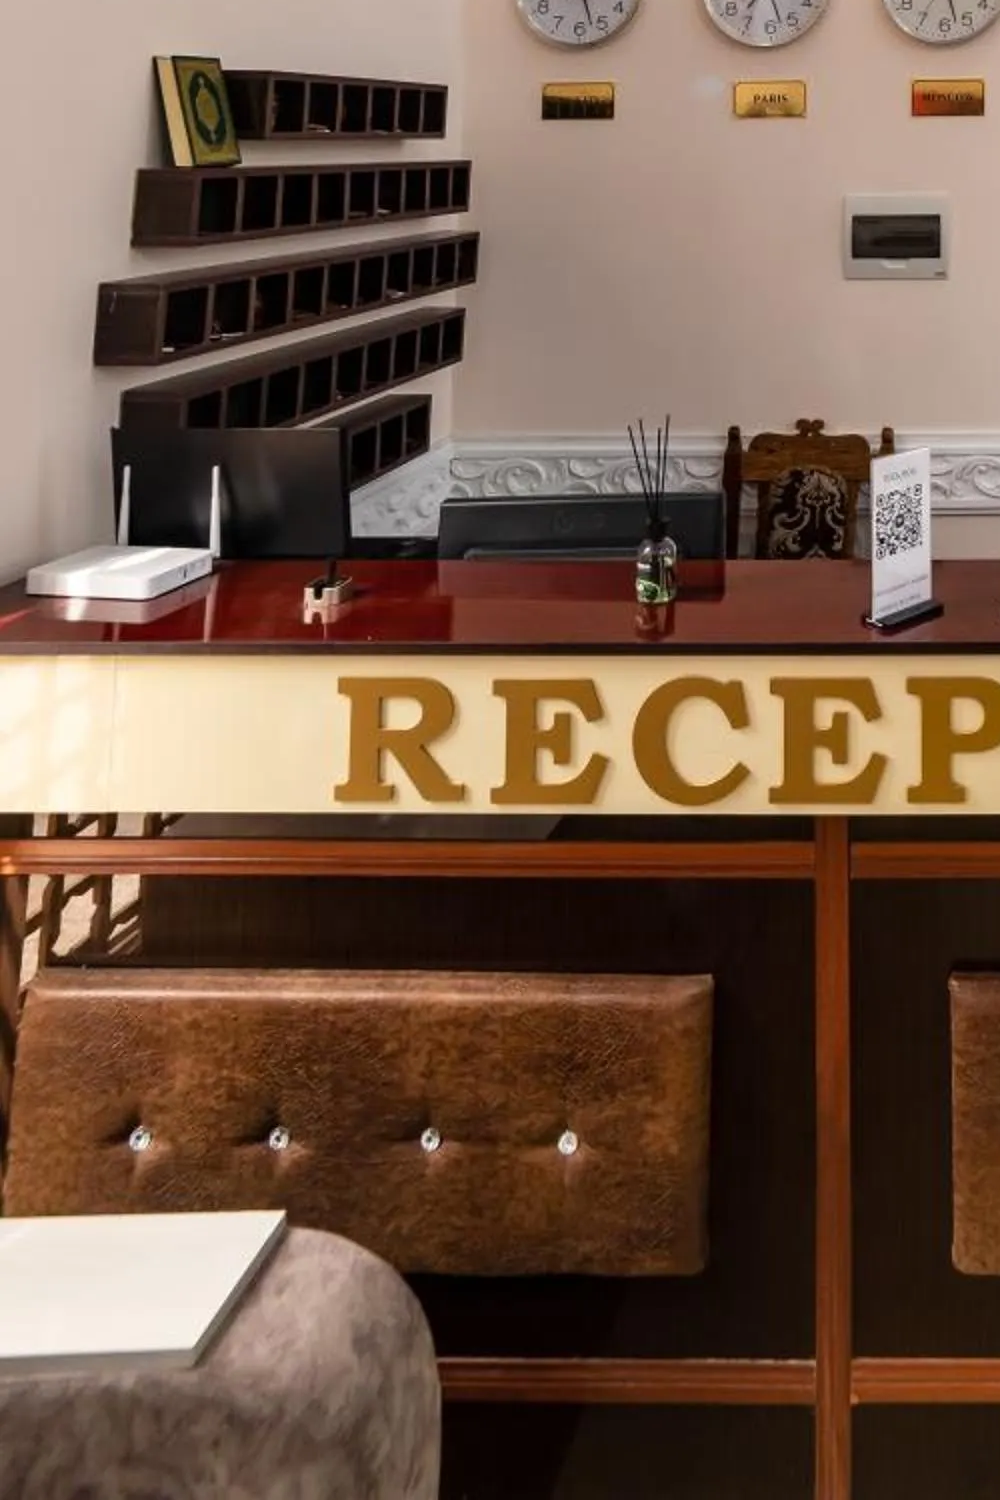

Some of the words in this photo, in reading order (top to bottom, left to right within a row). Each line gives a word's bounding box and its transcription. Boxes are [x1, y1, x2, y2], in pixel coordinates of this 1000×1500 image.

[612, 0, 624, 14] 4
[725, 1, 739, 17] 8
[553, 14, 565, 31] 7
[595, 15, 609, 31] 5
[743, 15, 753, 31] 7
[786, 11, 799, 27] 5
[918, 10, 928, 26] 7
[939, 17, 952, 33] 6
[960, 11, 973, 27] 5
[573, 21, 587, 37] 6
[764, 19, 777, 35] 6
[753, 94, 790, 104] PARIS
